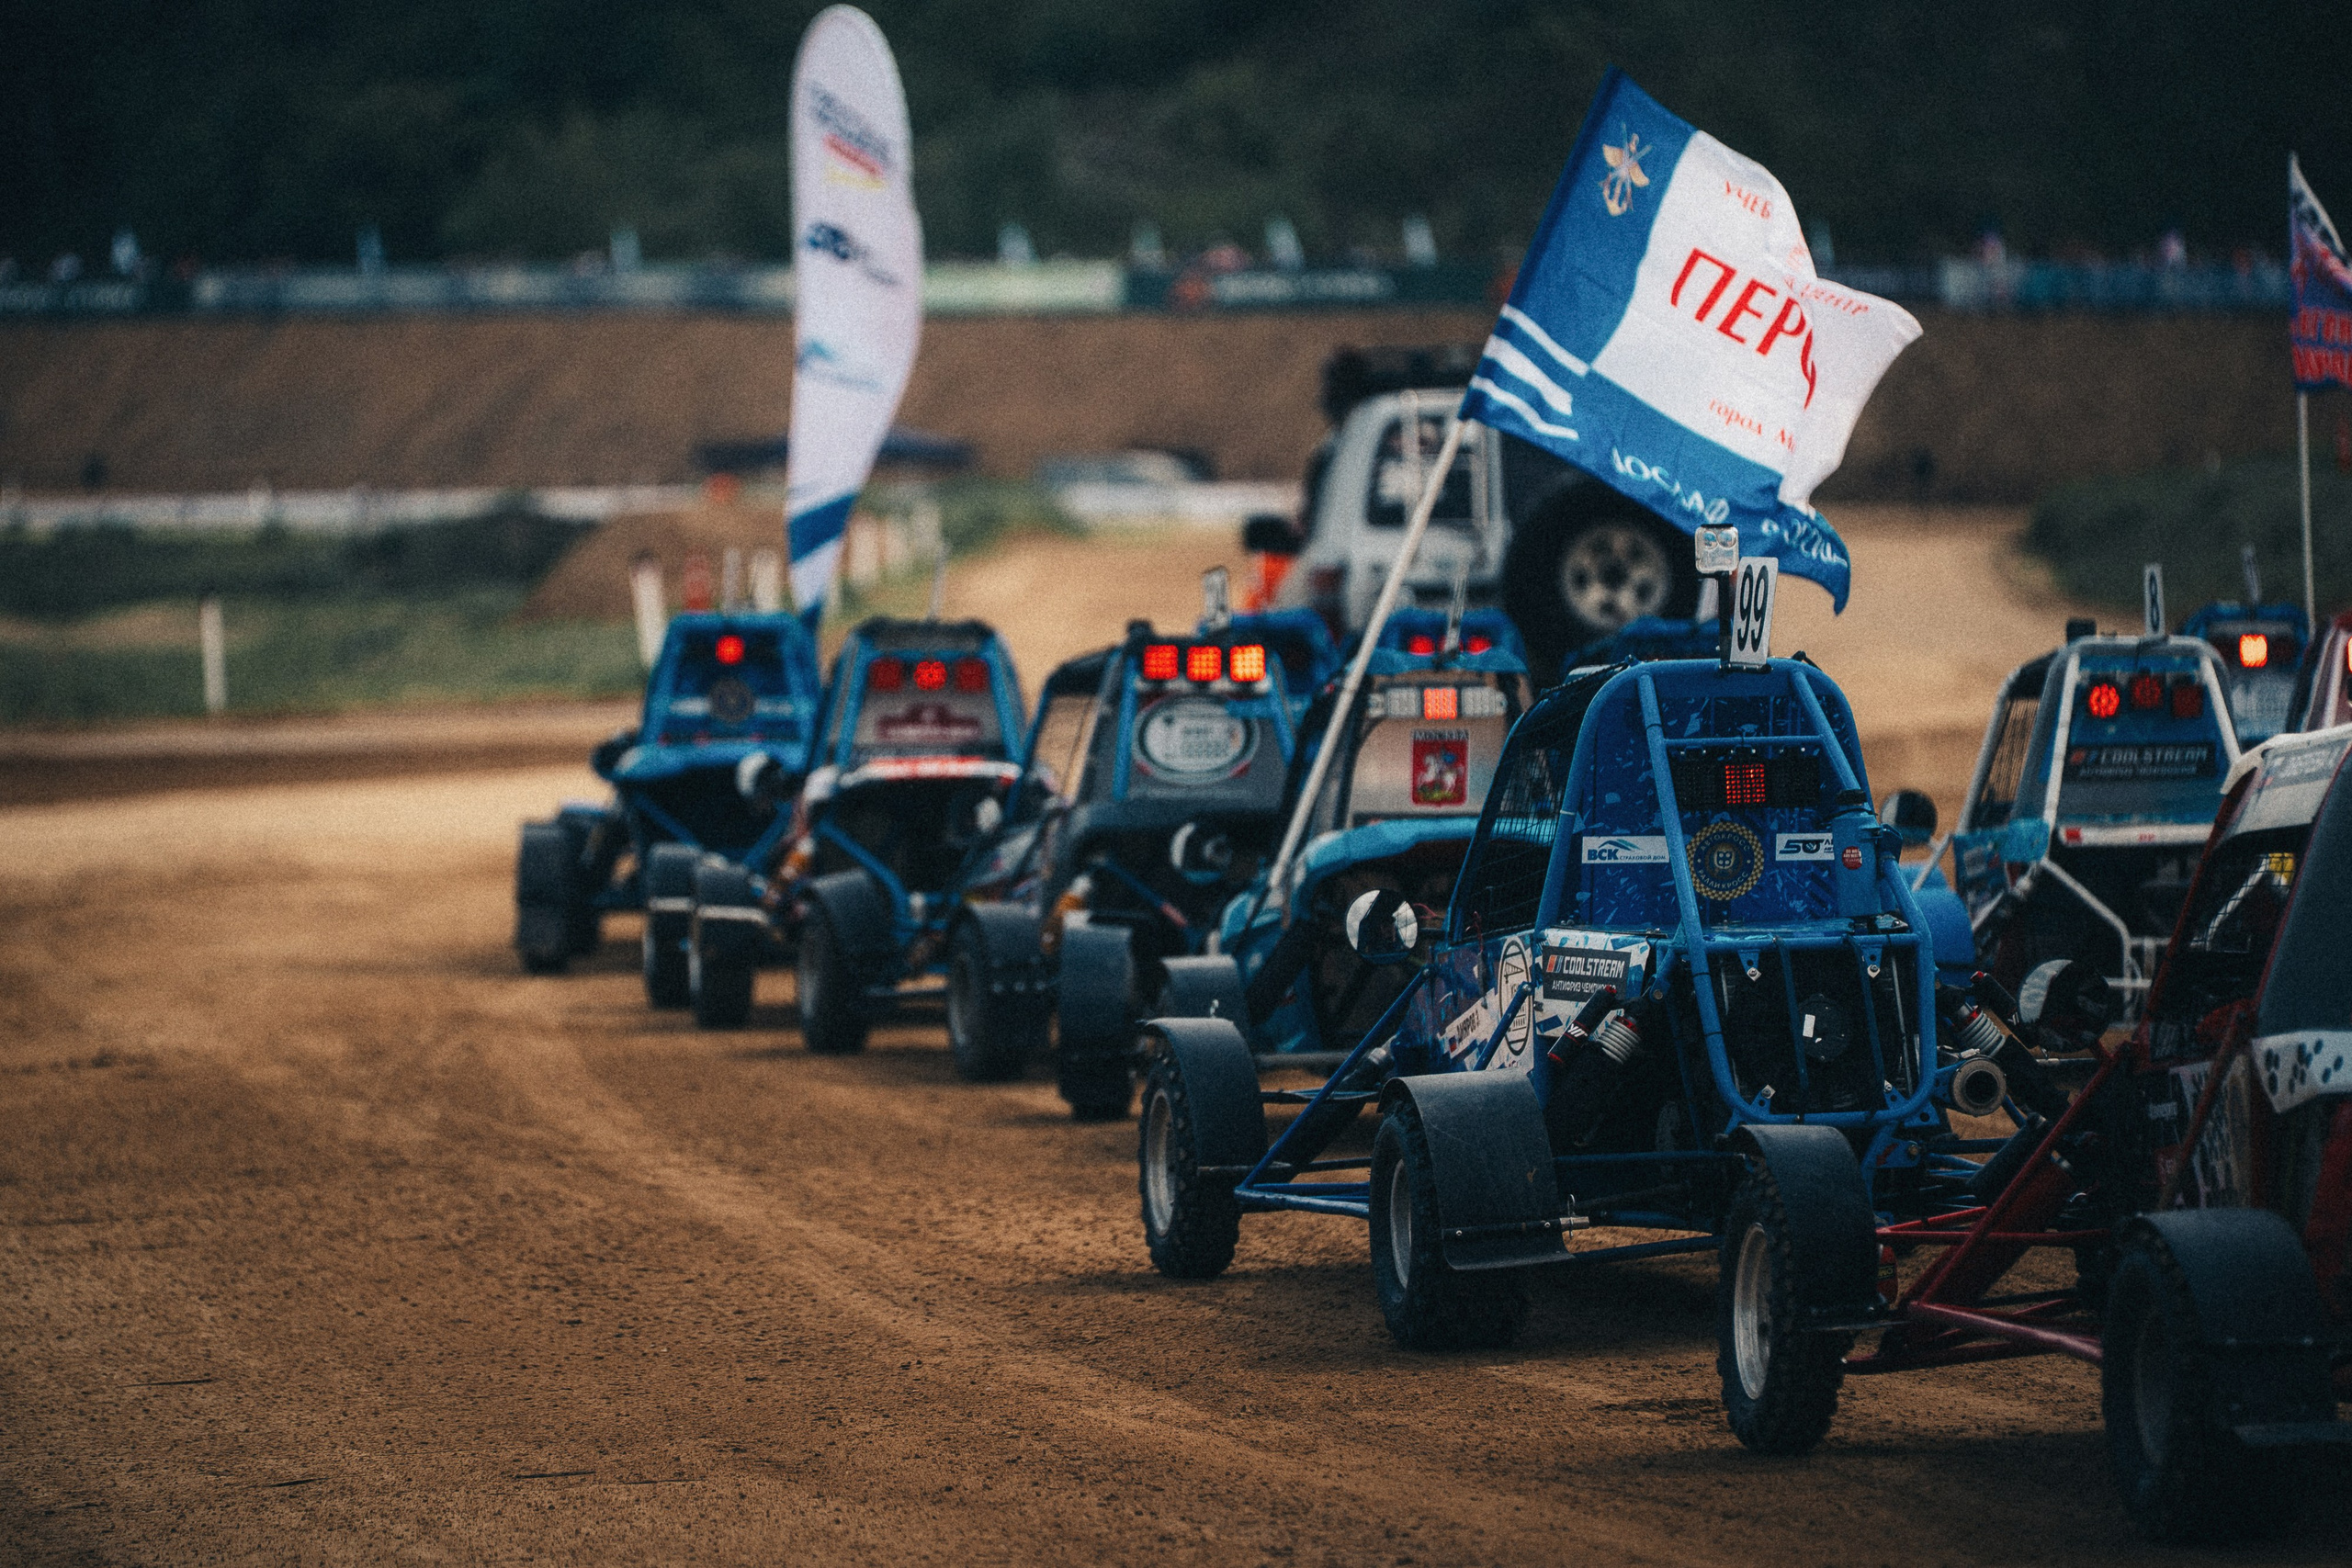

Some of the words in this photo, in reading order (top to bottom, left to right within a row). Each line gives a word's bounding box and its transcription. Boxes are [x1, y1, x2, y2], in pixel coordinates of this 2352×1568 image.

[1737, 564, 1769, 653] 99
[1700, 833, 1750, 852] АВТОКРОСС
[1587, 849, 1619, 861] ВСК
[1698, 869, 1748, 889] РАЛЛИКРОСС
[1563, 955, 1625, 979] COOLSTREAM
[1552, 979, 1581, 993] АНТИФРИЗ
